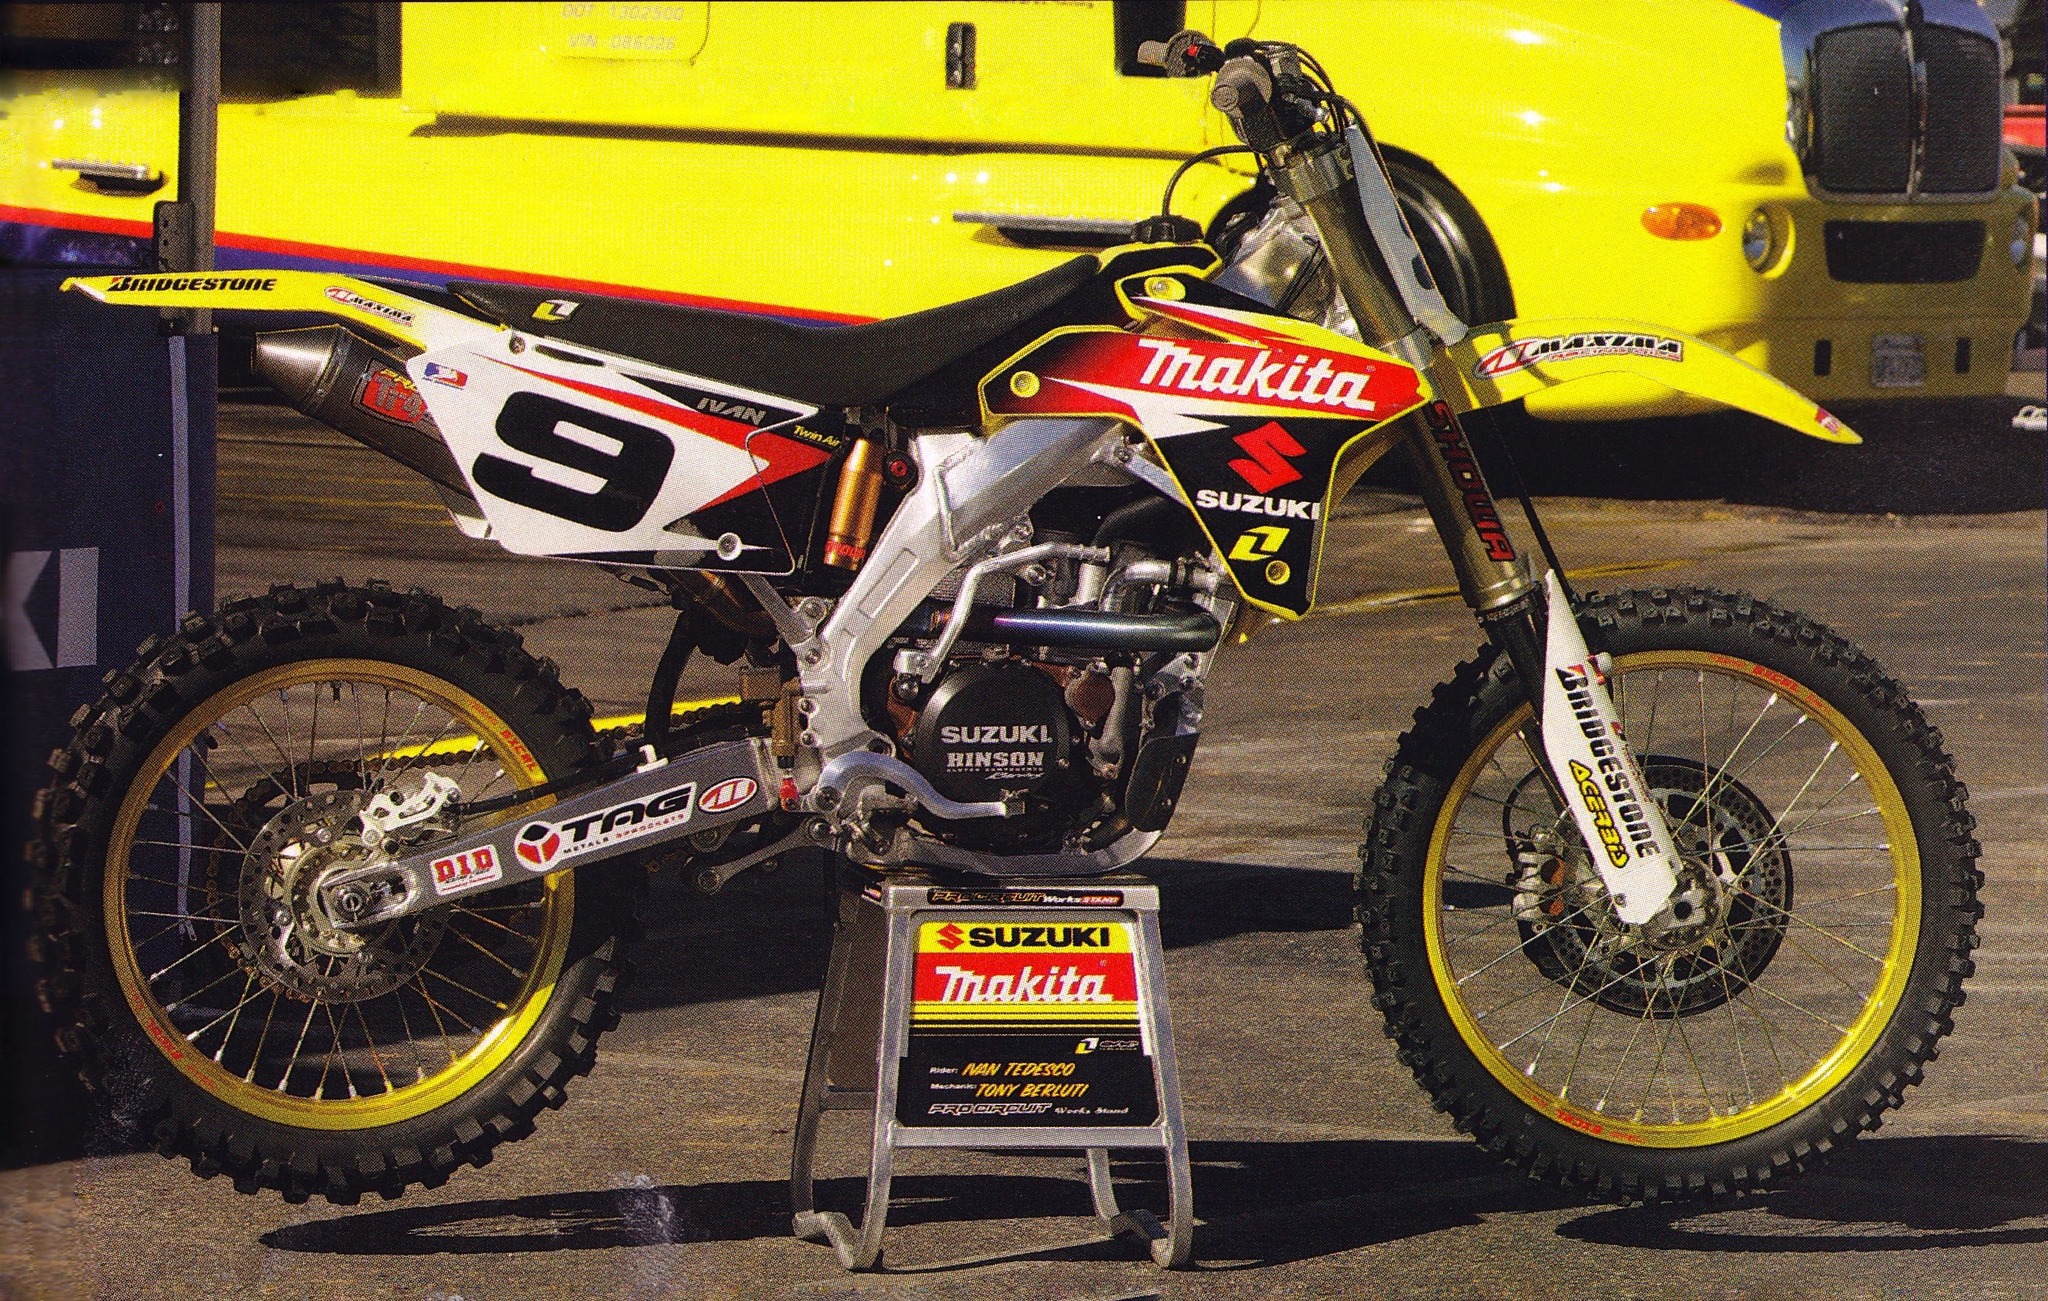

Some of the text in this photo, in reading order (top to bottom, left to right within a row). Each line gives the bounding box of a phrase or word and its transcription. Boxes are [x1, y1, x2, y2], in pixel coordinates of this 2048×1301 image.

[107, 276, 278, 292] BRIDGESTONE
[1529, 334, 1681, 356] MAXIMA
[697, 397, 767, 426] IVAN
[793, 424, 842, 448] Twin Air
[471, 390, 675, 533] 9
[1423, 400, 1516, 562] SHOWA
[1196, 489, 1319, 521] SUZUKI
[940, 724, 1049, 744] SUZUKI
[947, 751, 1045, 767] HINSON
[1555, 663, 1661, 859] BRIDGESTONE
[561, 786, 692, 843] TAG
[1043, 894, 1082, 904] Works
[969, 926, 1110, 948] SUZUKI
[929, 1062, 1076, 1077] Rider: IVAN TEDESCO
[929, 1082, 1090, 1098] Mechanic: TONY BERLUTI
